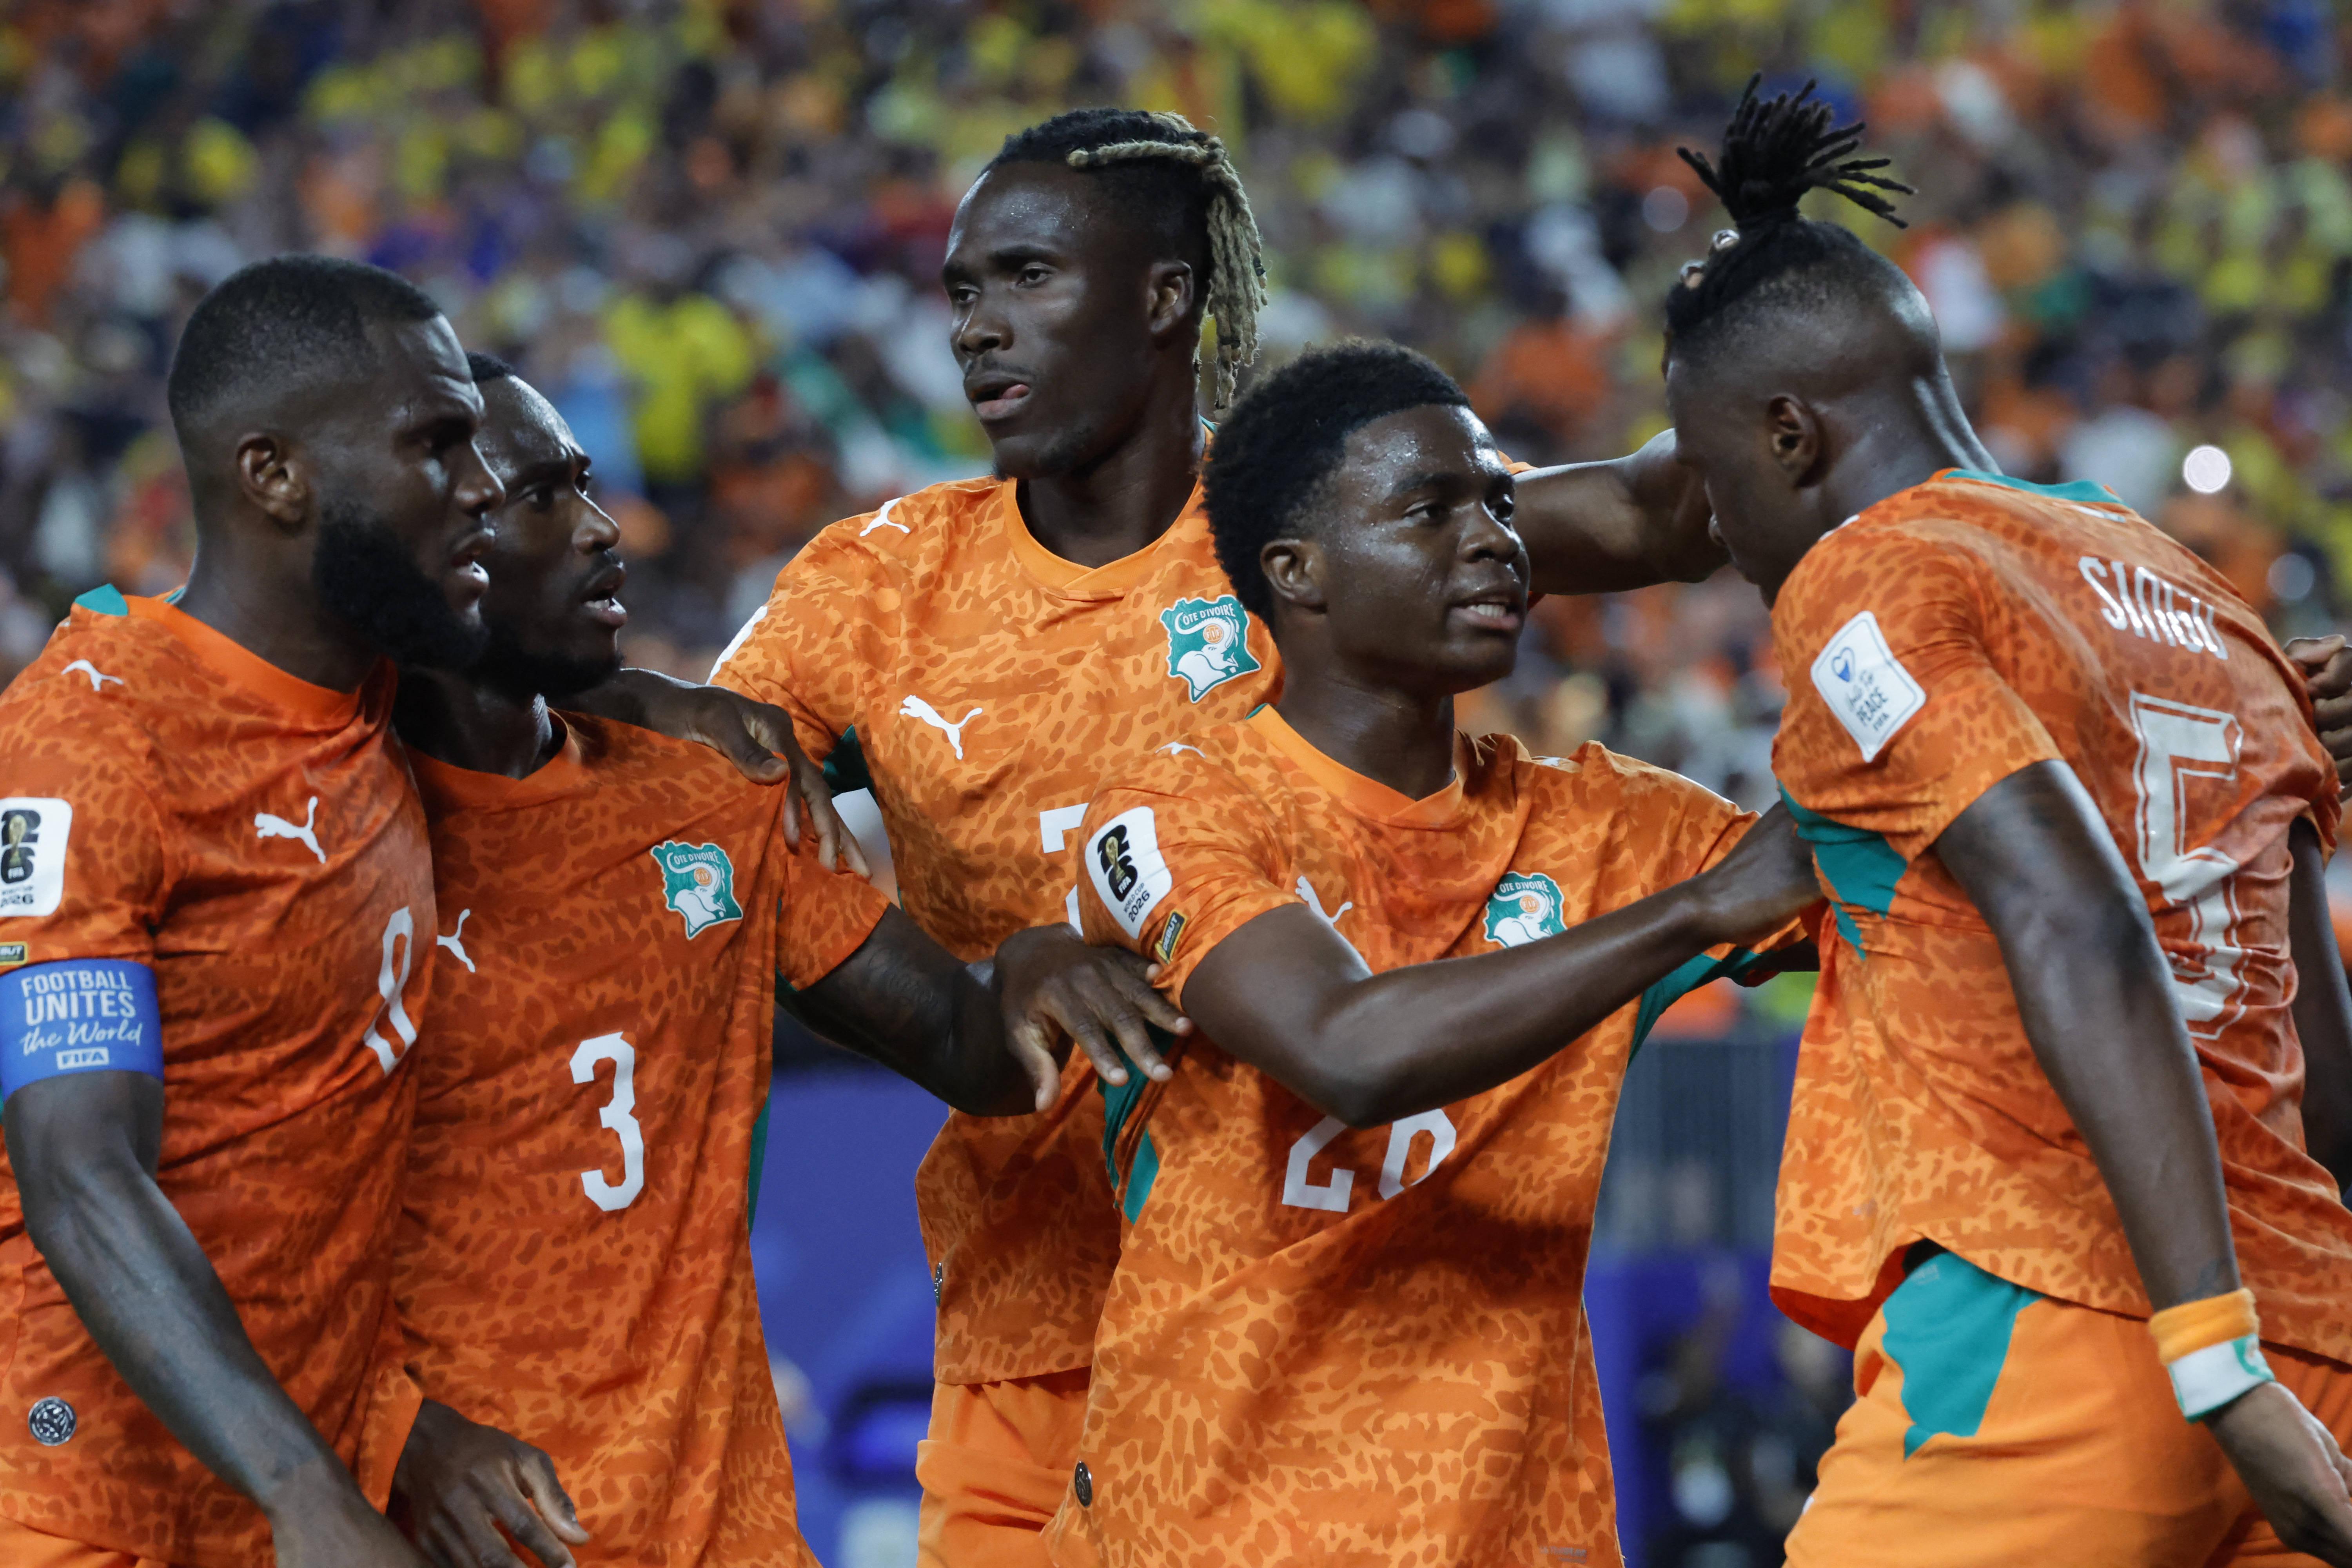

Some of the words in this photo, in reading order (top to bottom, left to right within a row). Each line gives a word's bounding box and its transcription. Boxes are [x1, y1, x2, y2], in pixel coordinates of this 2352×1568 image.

[1200, 603, 1236, 619] D'IVOIRE
[2129, 690, 2250, 1041] 5
[1118, 876, 1132, 894] FIFA
[1123, 893, 1136, 913] WORLD
[1134, 882, 1145, 896] CUP
[1515, 880, 1550, 893] D'IVOIRE
[1128, 889, 1151, 923] 2026
[1163, 914, 1178, 951] DEBUT
[21, 970, 132, 998] FOOTBALL
[25, 991, 136, 1026] UNITES
[19, 1025, 62, 1056] the
[67, 1018, 143, 1046] World
[58, 1049, 107, 1067] FIFA
[569, 1031, 644, 1212] 3
